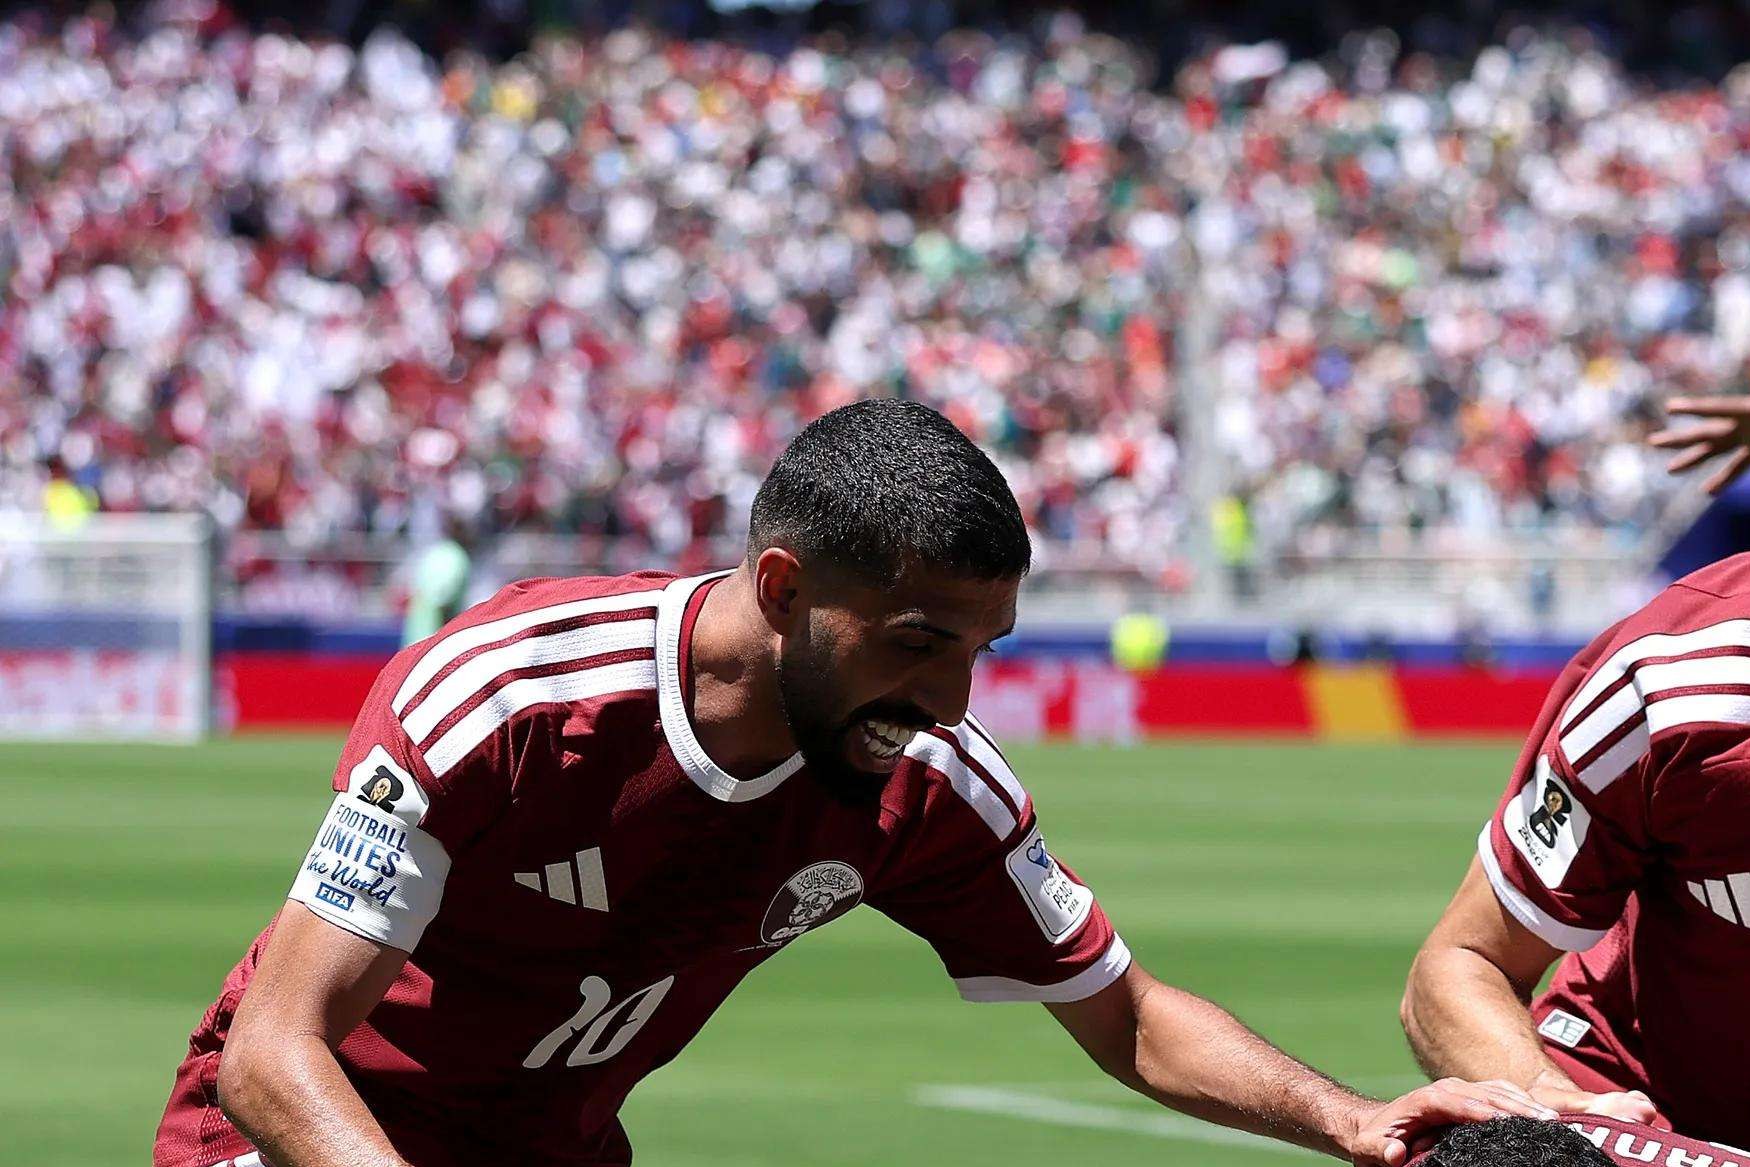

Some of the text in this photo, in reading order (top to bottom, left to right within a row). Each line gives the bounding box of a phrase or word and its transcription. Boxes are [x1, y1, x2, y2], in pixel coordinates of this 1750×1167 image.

[320, 823, 401, 878] UNITES
[335, 804, 408, 853] FOOTBALL
[306, 851, 397, 907] the World
[317, 885, 352, 910] FIFA
[1053, 881, 1073, 910] PEAC
[522, 975, 675, 1069] 10
